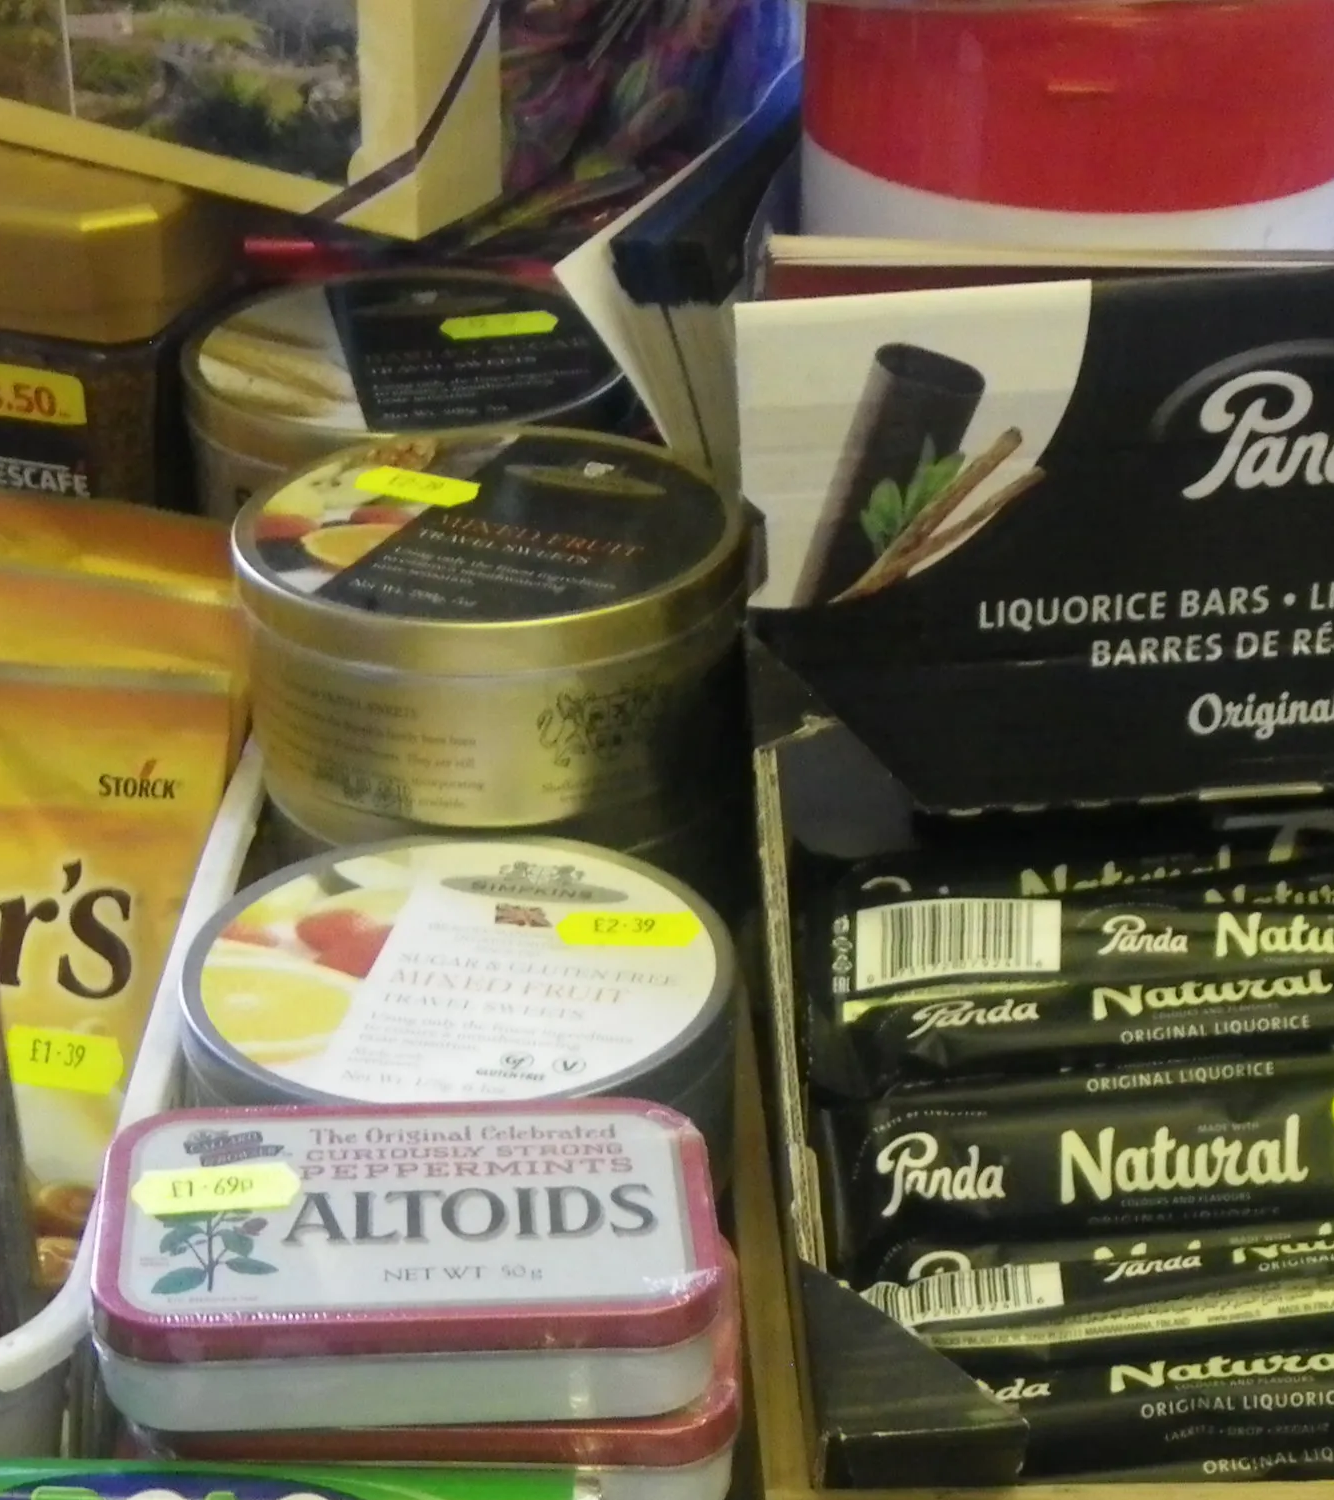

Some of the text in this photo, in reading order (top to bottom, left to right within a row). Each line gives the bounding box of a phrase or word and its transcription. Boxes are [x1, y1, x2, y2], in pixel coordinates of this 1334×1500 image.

[977, 590, 1167, 633] LIQUORICE
[1179, 584, 1271, 621] BARS
[1089, 632, 1224, 669] BARRES
[1234, 630, 1280, 660] DE
[98, 772, 177, 800] STORCK
[1097, 914, 1188, 956] Panda
[388, 968, 631, 1005] MIXED FRUIT
[907, 968, 1334, 1040] Panda Natural
[1119, 1014, 1311, 1045] ORIGINAL LIQUORICE
[1085, 1060, 1276, 1094] ORIGINAL LIQUORICE
[309, 1123, 617, 1146] The Original Celebrated
[299, 1157, 635, 1181] PEPPERMINTS
[306, 1142, 624, 1162] CURIOUSLY STRONG
[1060, 1112, 1310, 1205] Natural
[875, 1130, 1007, 1218] Panda
[281, 1183, 660, 1248] ALTOIDS
[383, 1265, 438, 1283] NET
[1140, 1395, 1236, 1420] ORIGINAL
[1202, 1450, 1297, 1475] ORIGINAL
